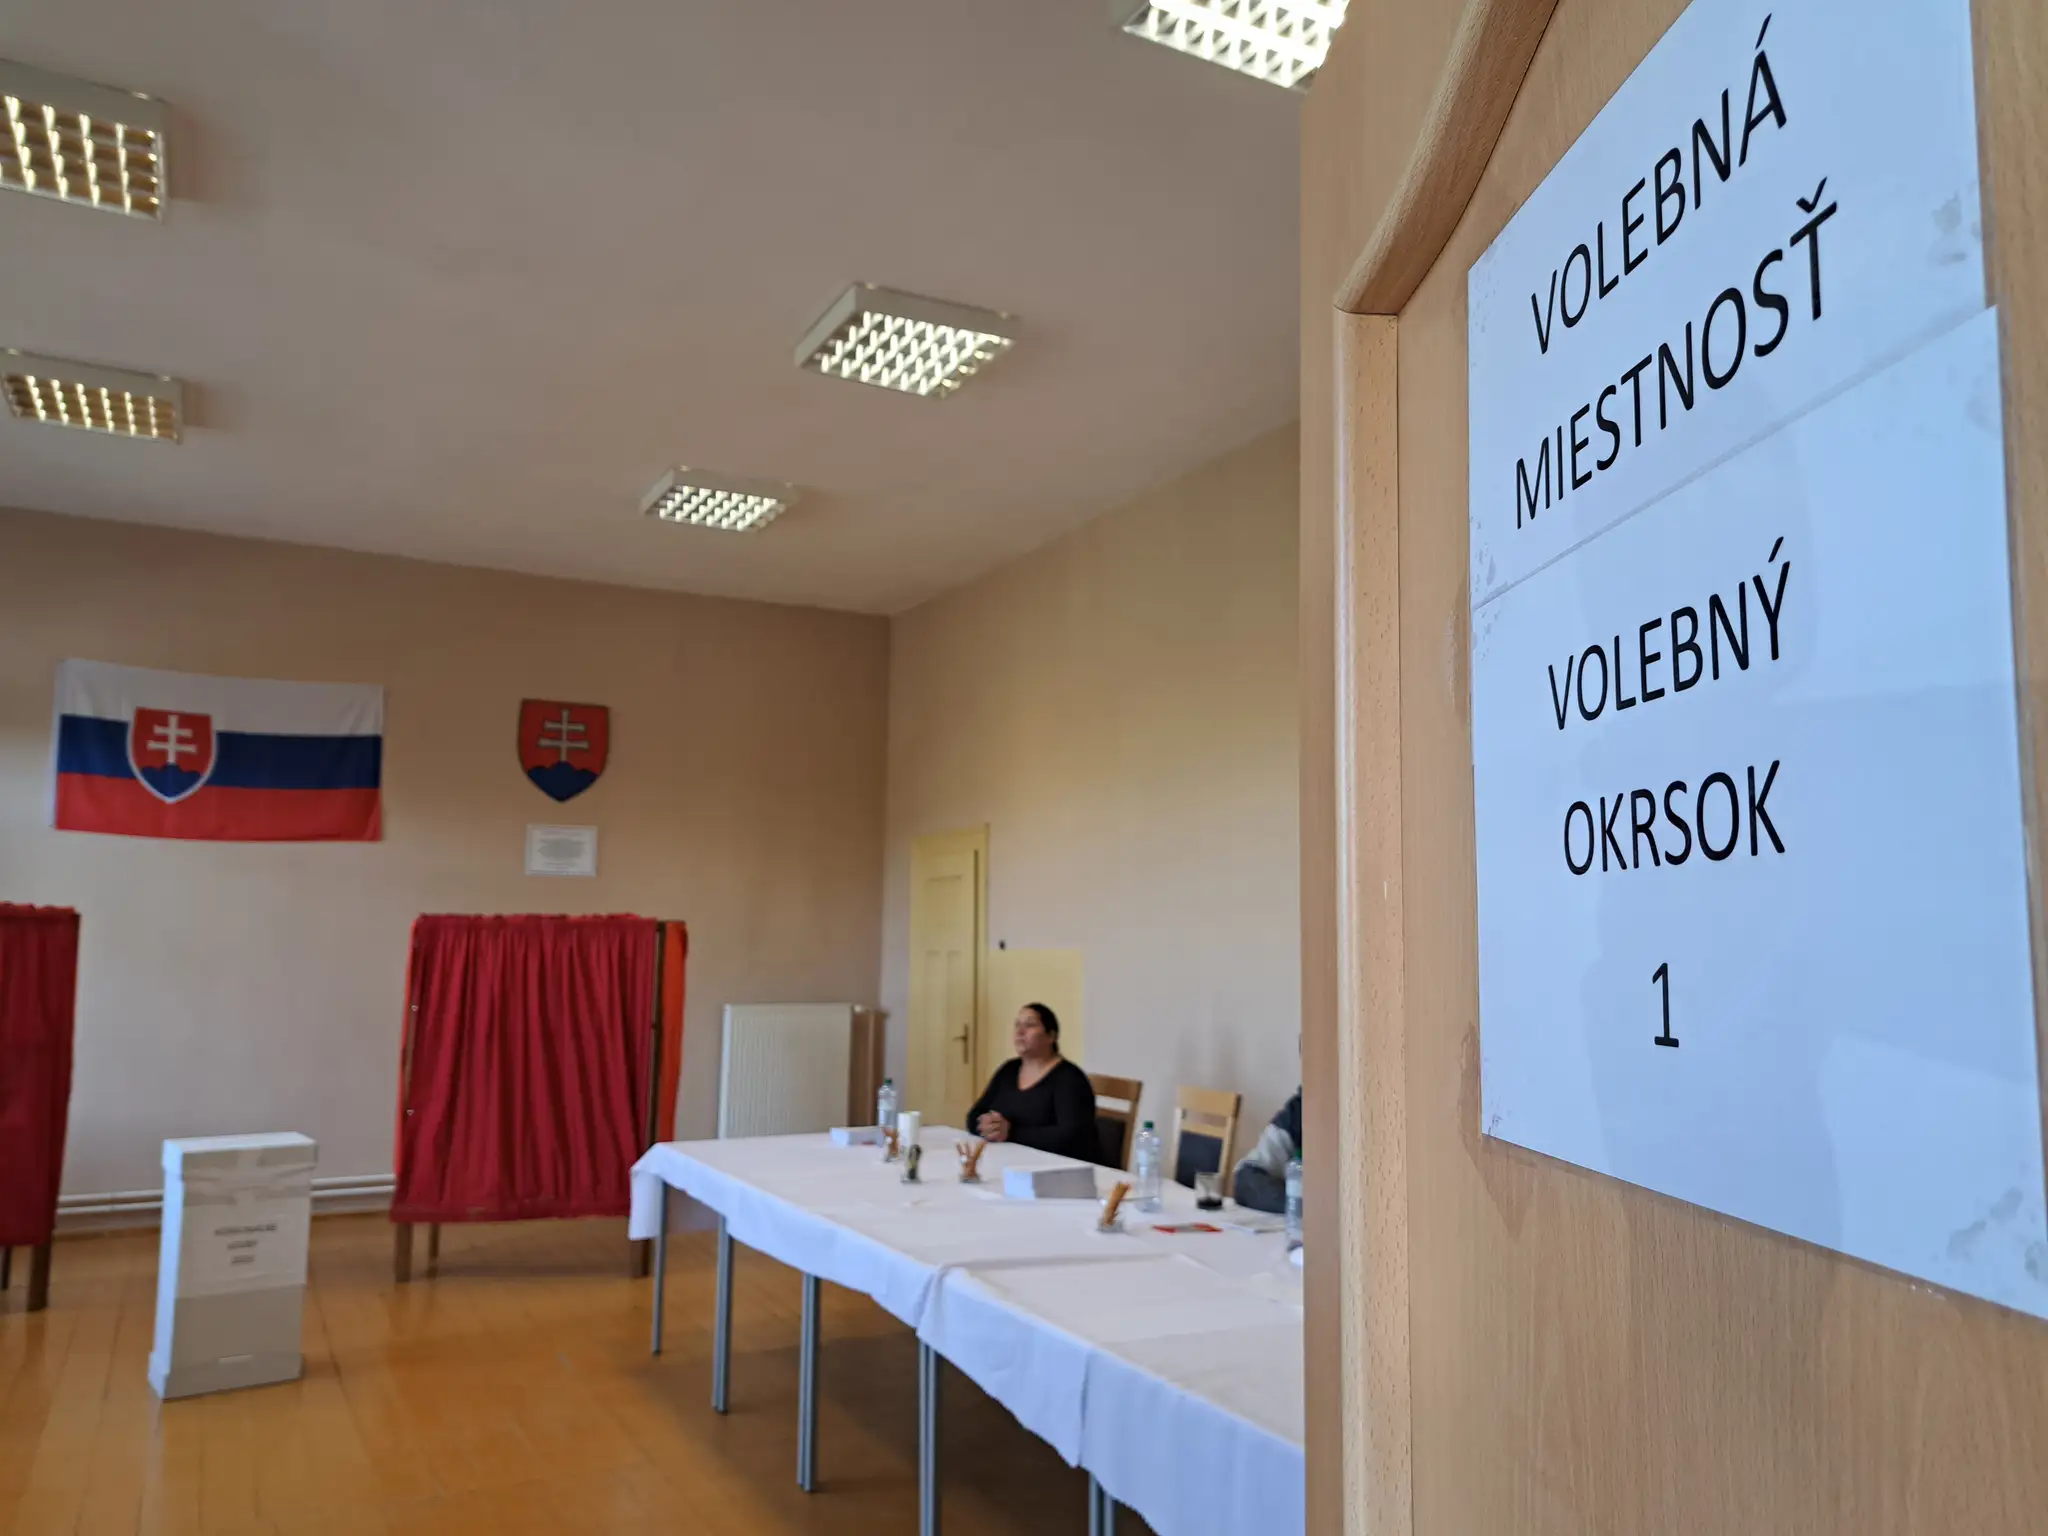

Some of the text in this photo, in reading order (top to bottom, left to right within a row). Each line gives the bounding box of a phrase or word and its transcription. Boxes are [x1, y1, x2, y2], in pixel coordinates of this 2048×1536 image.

[1530, 13, 1788, 355] VOLEBNÁ
[1516, 176, 1838, 530] MIESTNOSŤ
[1547, 536, 1791, 731] VOLEBNÝ
[1563, 759, 1786, 877] OKRSOK
[1651, 962, 1680, 1049] 1
